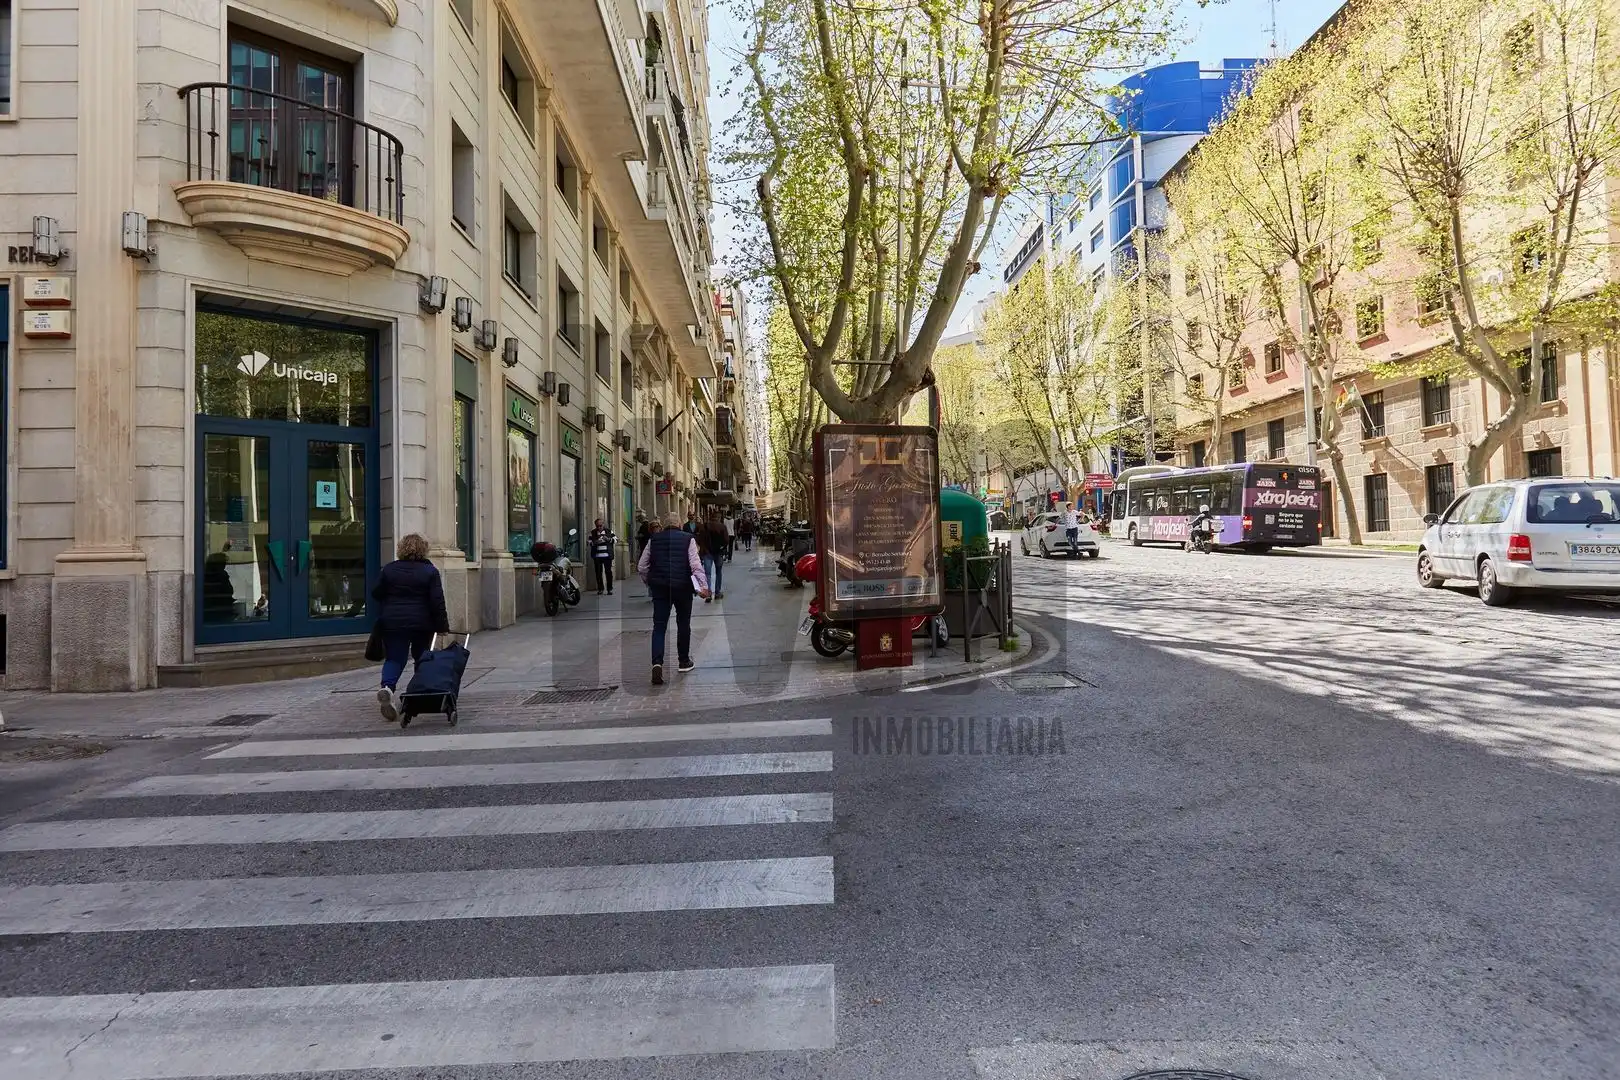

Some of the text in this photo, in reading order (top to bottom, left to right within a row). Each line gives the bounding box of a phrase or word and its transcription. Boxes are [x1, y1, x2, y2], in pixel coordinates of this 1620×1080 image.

[273, 362, 338, 386] Unicaja
[1578, 546, 1602, 554] 3849
[863, 583, 885, 593] BOSS
